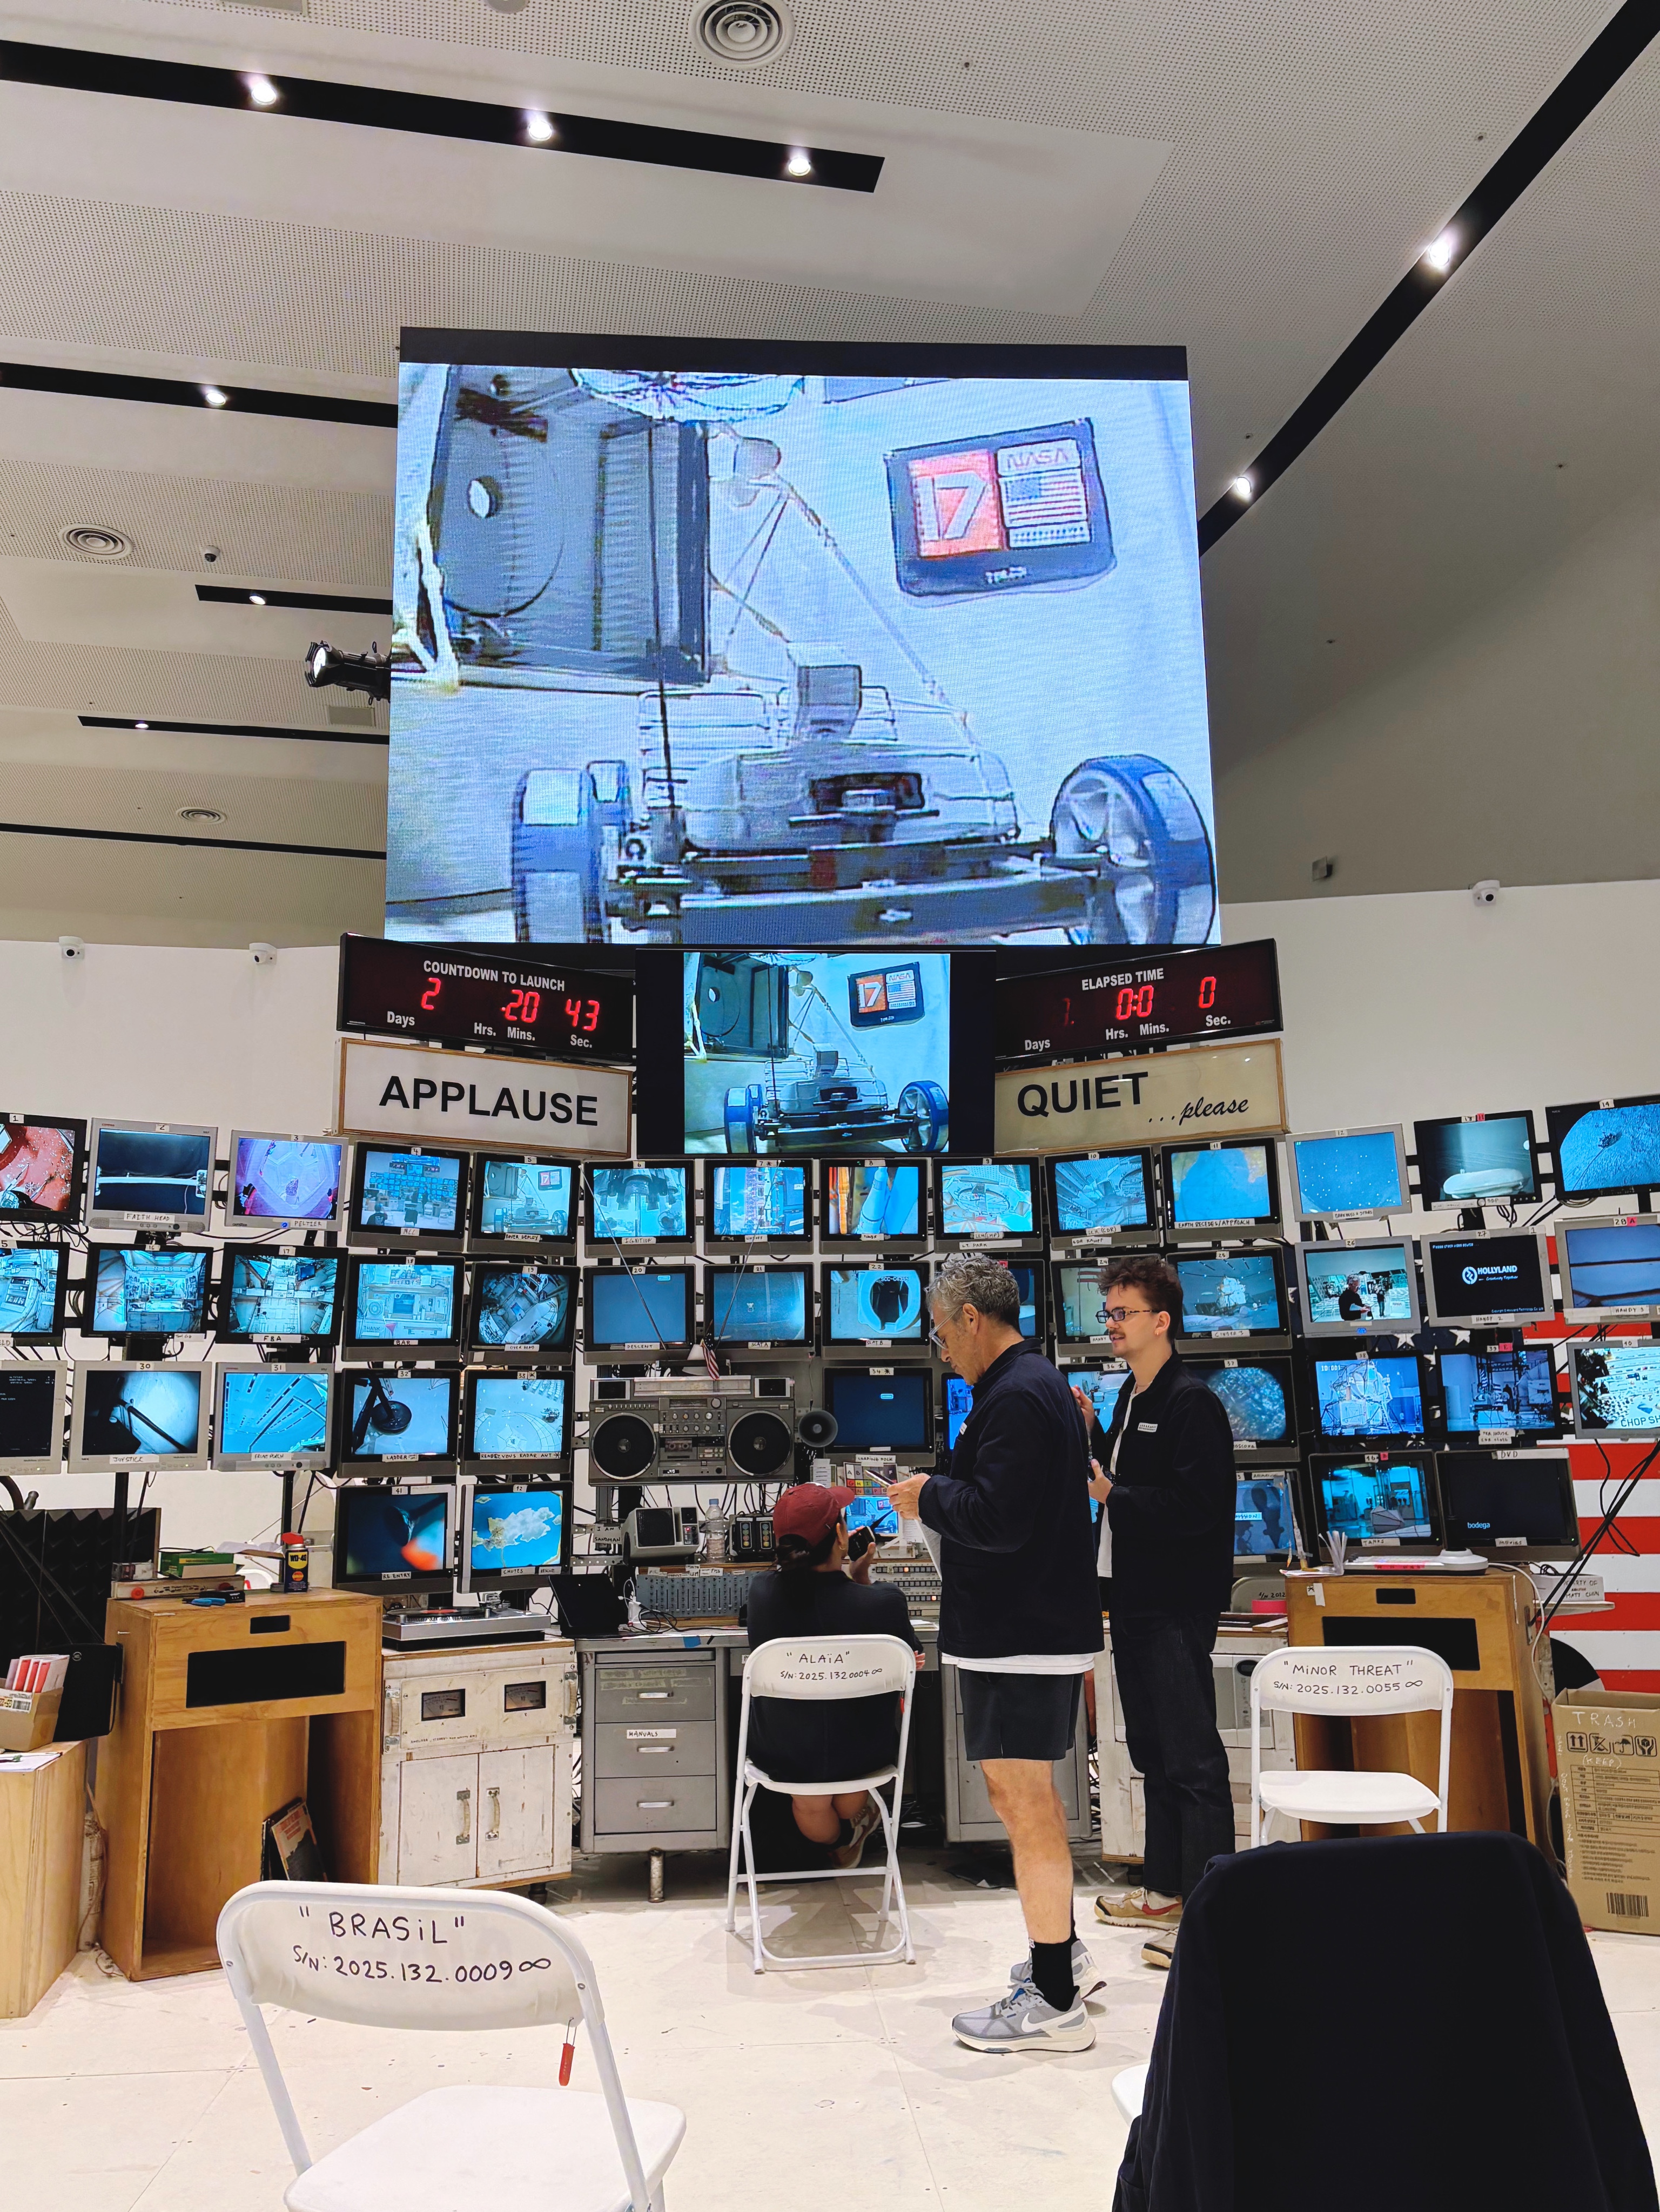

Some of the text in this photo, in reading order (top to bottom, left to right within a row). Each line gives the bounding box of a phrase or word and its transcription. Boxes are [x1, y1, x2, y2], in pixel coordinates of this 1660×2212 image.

[424, 960, 565, 992] COUNTDOWN TO LAUNCH
[1081, 968, 1164, 990] ELAPSED TIME
[421, 977, 441, 1010] 2
[565, 999, 600, 1031] 43
[1199, 976, 1217, 1009] 0
[387, 1011, 593, 1048] Days Hrs. Mins. Sec.
[1025, 1014, 1231, 1052] Days Hrs. Mins. Sec.
[379, 1075, 598, 1127] APPLAUSE
[1017, 1071, 1148, 1118] QUIET
[126, 1213, 151, 1221] FAITH
[1477, 1265, 1518, 1275] HOLLYLAND
[1621, 1417, 1646, 1427] CHOP
[1571, 1711, 1636, 1728] TRASH
